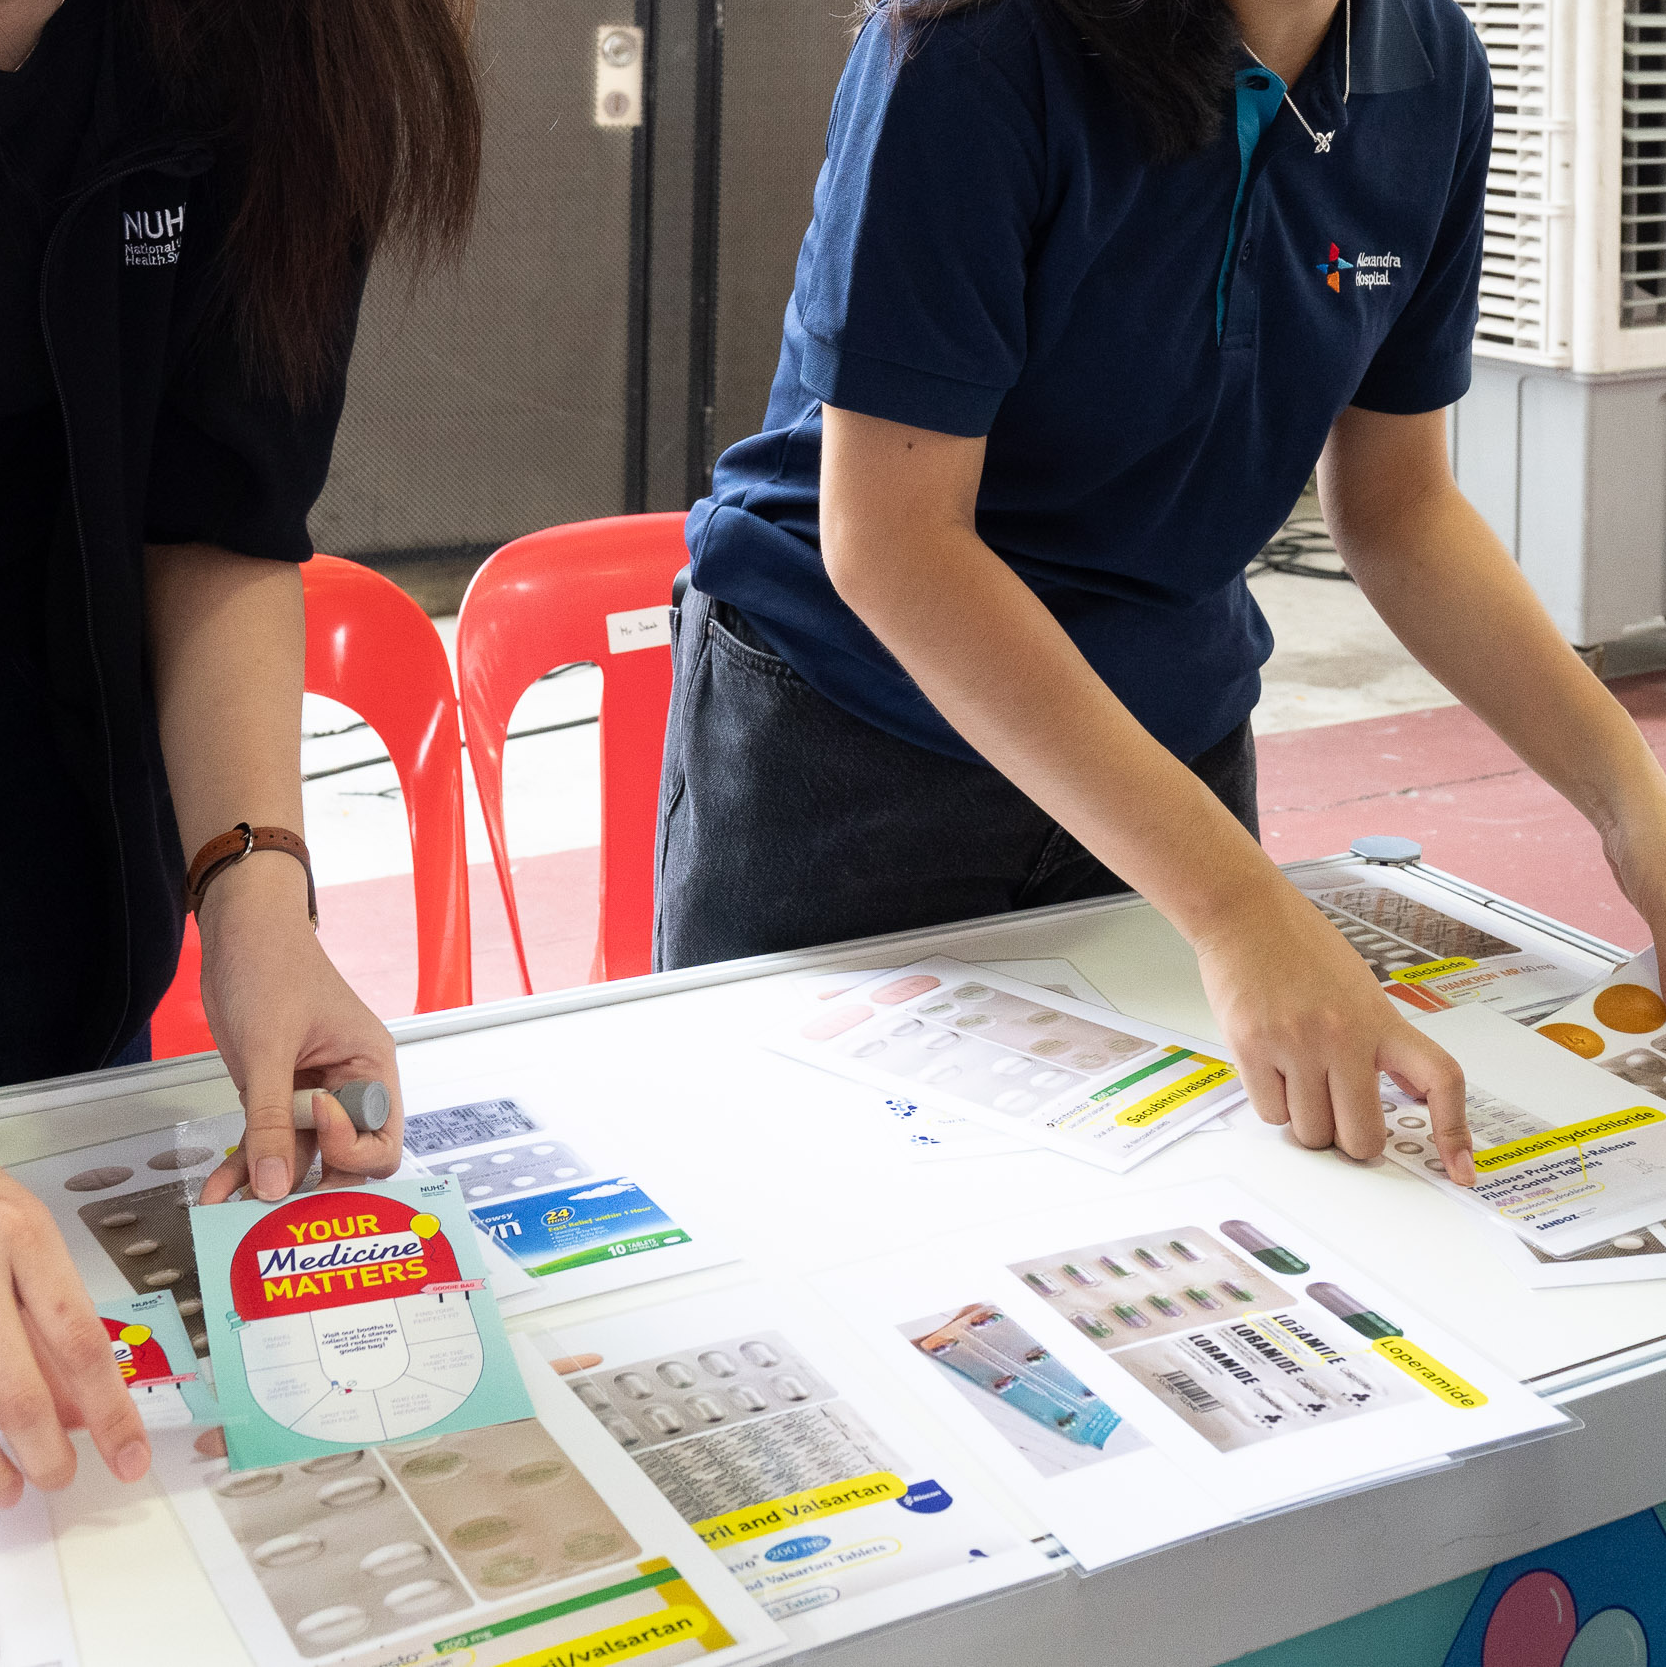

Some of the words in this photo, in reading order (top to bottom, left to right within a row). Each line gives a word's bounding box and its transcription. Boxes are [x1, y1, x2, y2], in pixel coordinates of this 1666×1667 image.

[122, 205, 184, 240] NUH
[125, 240, 176, 256] National
[125, 254, 165, 266] Health
[1356, 251, 1402, 268] Alexandra
[1355, 269, 1391, 290] Hospital
[1404, 960, 1468, 981] Gliclazide
[1435, 972, 1500, 993] DIAMICRON
[1521, 964, 1537, 974] 60
[1537, 963, 1558, 973] mg
[1126, 1067, 1233, 1125] Sacubitril/valsartan
[1474, 1140, 1557, 1169] Tamsulosin
[1555, 1110, 1655, 1145] hydrochloride
[1467, 1172, 1527, 1195] Tasulose
[1529, 1139, 1638, 1176] Prolonged-Release
[420, 1184, 445, 1193] NUHS
[1481, 1172, 1559, 1202] Film-Coated
[1558, 1159, 1603, 1178] Tablets
[546, 1208, 570, 1221] 24
[547, 1217, 570, 1225] Hour
[548, 1224, 568, 1232] Fast
[568, 1218, 593, 1228] Relief
[594, 1212, 622, 1222] within
[1535, 1213, 1581, 1231] SANDOZ
[286, 1214, 381, 1244] YOUR
[608, 1244, 627, 1257] 10
[627, 1238, 657, 1249] TABLETS
[259, 1241, 424, 1278] Medicine
[263, 1259, 429, 1302] MATTERS
[432, 1284, 459, 1292] GOODIE
[321, 1336, 348, 1345] collect
[349, 1333, 360, 1341] all
[368, 1328, 398, 1337] stamps
[322, 1331, 340, 1339] Visit
[356, 1325, 385, 1334] booths
[350, 1337, 382, 1346] redeem
[1272, 1313, 1347, 1366] LORAMIDE
[338, 1346, 366, 1355] goodie
[367, 1342, 386, 1350] bag!
[1230, 1323, 1305, 1376] LORAMIDE
[1188, 1333, 1261, 1386] LORAMIDE
[1379, 1340, 1475, 1407] Loperamide
[738, 1511, 781, 1533] and
[783, 1481, 891, 1518] Valsartan
[766, 1544, 798, 1561] 200
[802, 1537, 828, 1551] mg
[765, 1560, 834, 1585] Valsartan
[832, 1543, 888, 1564] Tablets
[785, 1591, 831, 1611] Tablets
